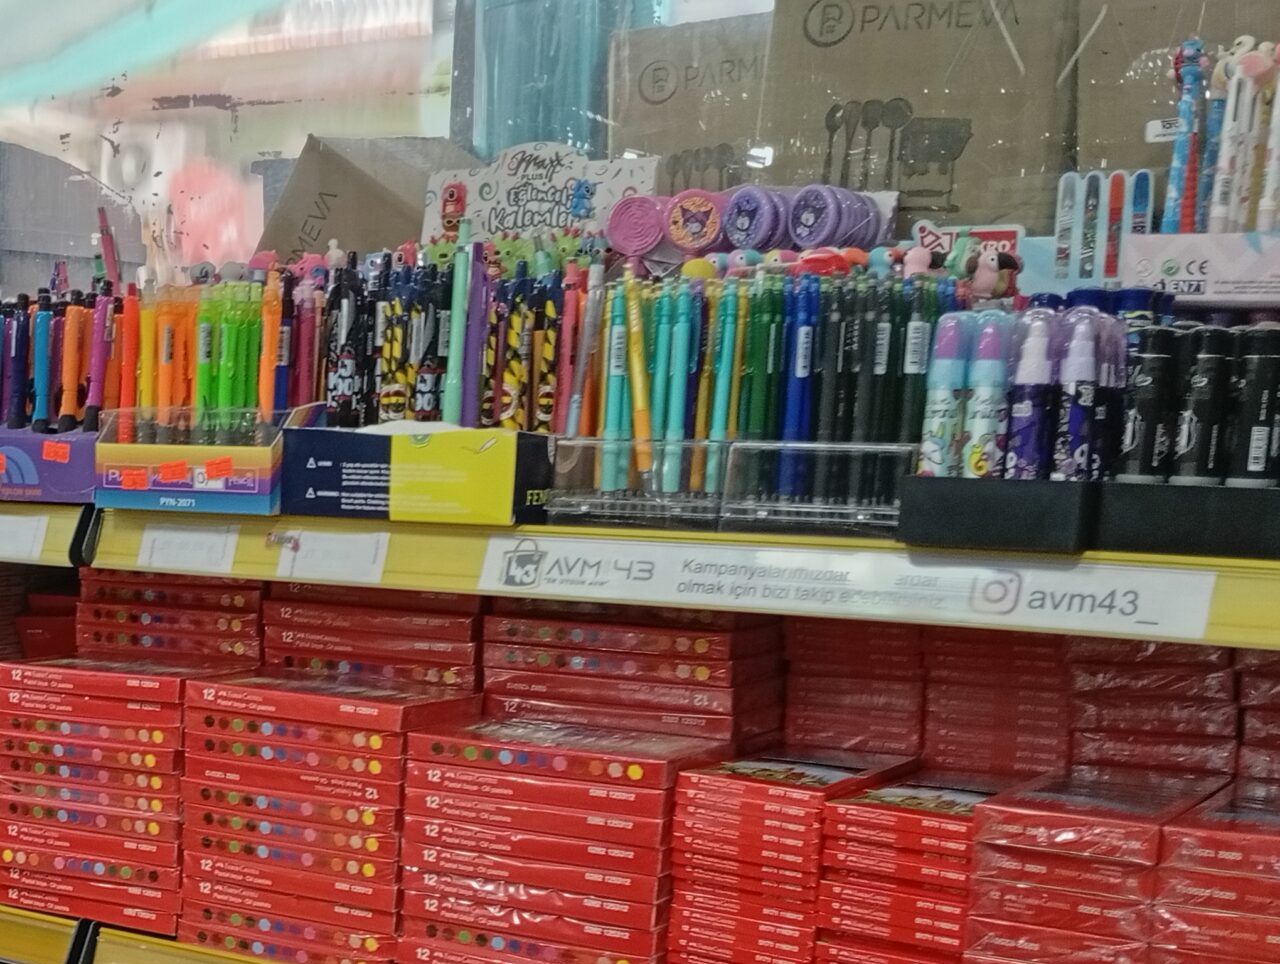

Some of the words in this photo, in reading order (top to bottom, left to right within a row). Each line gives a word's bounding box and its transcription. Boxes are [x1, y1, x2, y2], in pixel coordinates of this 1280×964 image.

[547, 556, 601, 578] AVM
[613, 560, 655, 582] 43
[677, 579, 725, 596] olmak
[727, 581, 757, 600] için
[761, 583, 790, 600] bizi
[1027, 588, 1159, 626] avm43_
[10, 669, 22, 681] 12
[202, 688, 216, 700] 12
[427, 769, 441, 782] 12
[425, 795, 440, 808] 12
[423, 872, 438, 886] 12
[416, 947, 430, 961] 12
